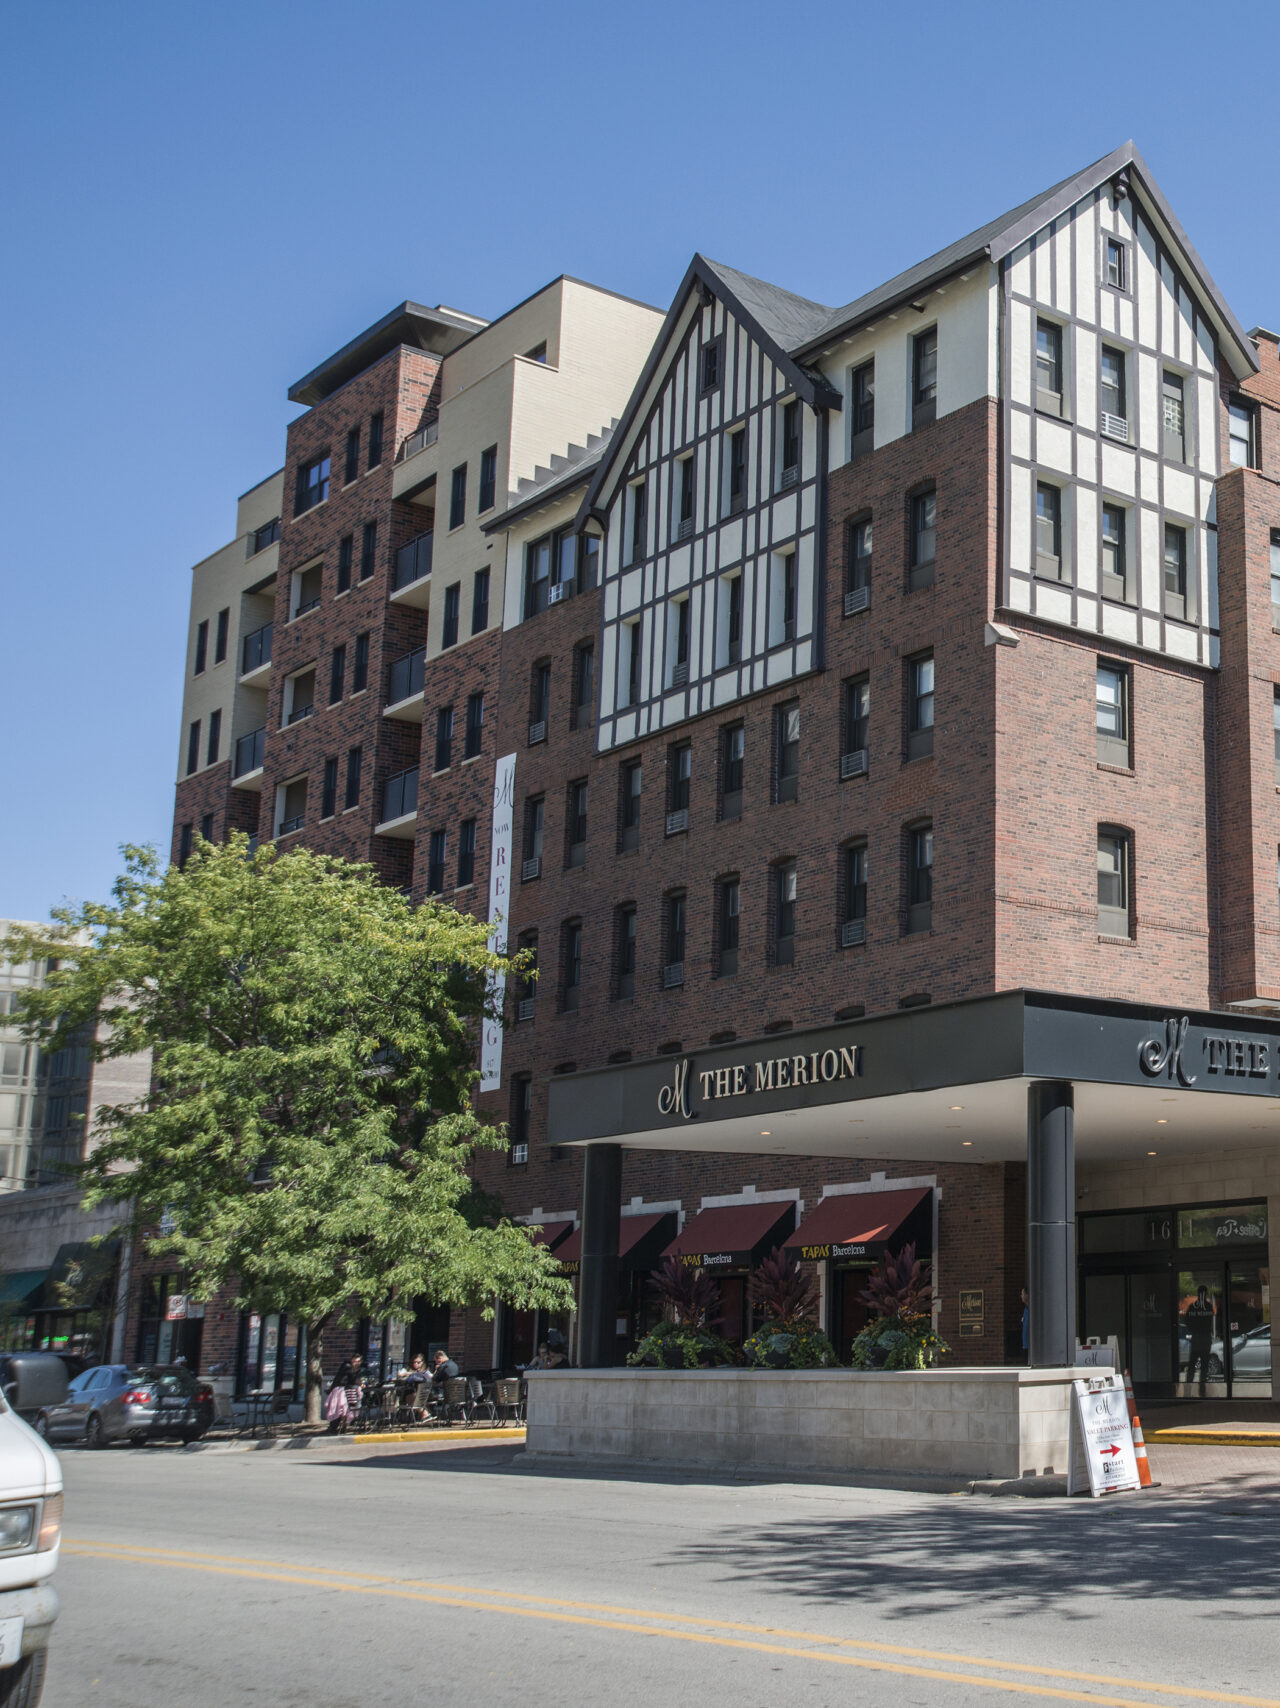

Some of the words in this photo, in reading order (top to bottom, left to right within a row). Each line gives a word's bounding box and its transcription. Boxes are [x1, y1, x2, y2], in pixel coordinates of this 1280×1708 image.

[1204, 1037, 1271, 1075] THE
[700, 1065, 747, 1100] THE
[755, 1045, 857, 1092] MERION
[801, 1245, 829, 1258] TAPAS
[832, 1243, 865, 1256] Barcelona
[680, 1253, 701, 1267] APAS
[703, 1253, 732, 1265] Barcelona
[1086, 1427, 1104, 1436] VALET
[1103, 1423, 1129, 1434] PARKING
